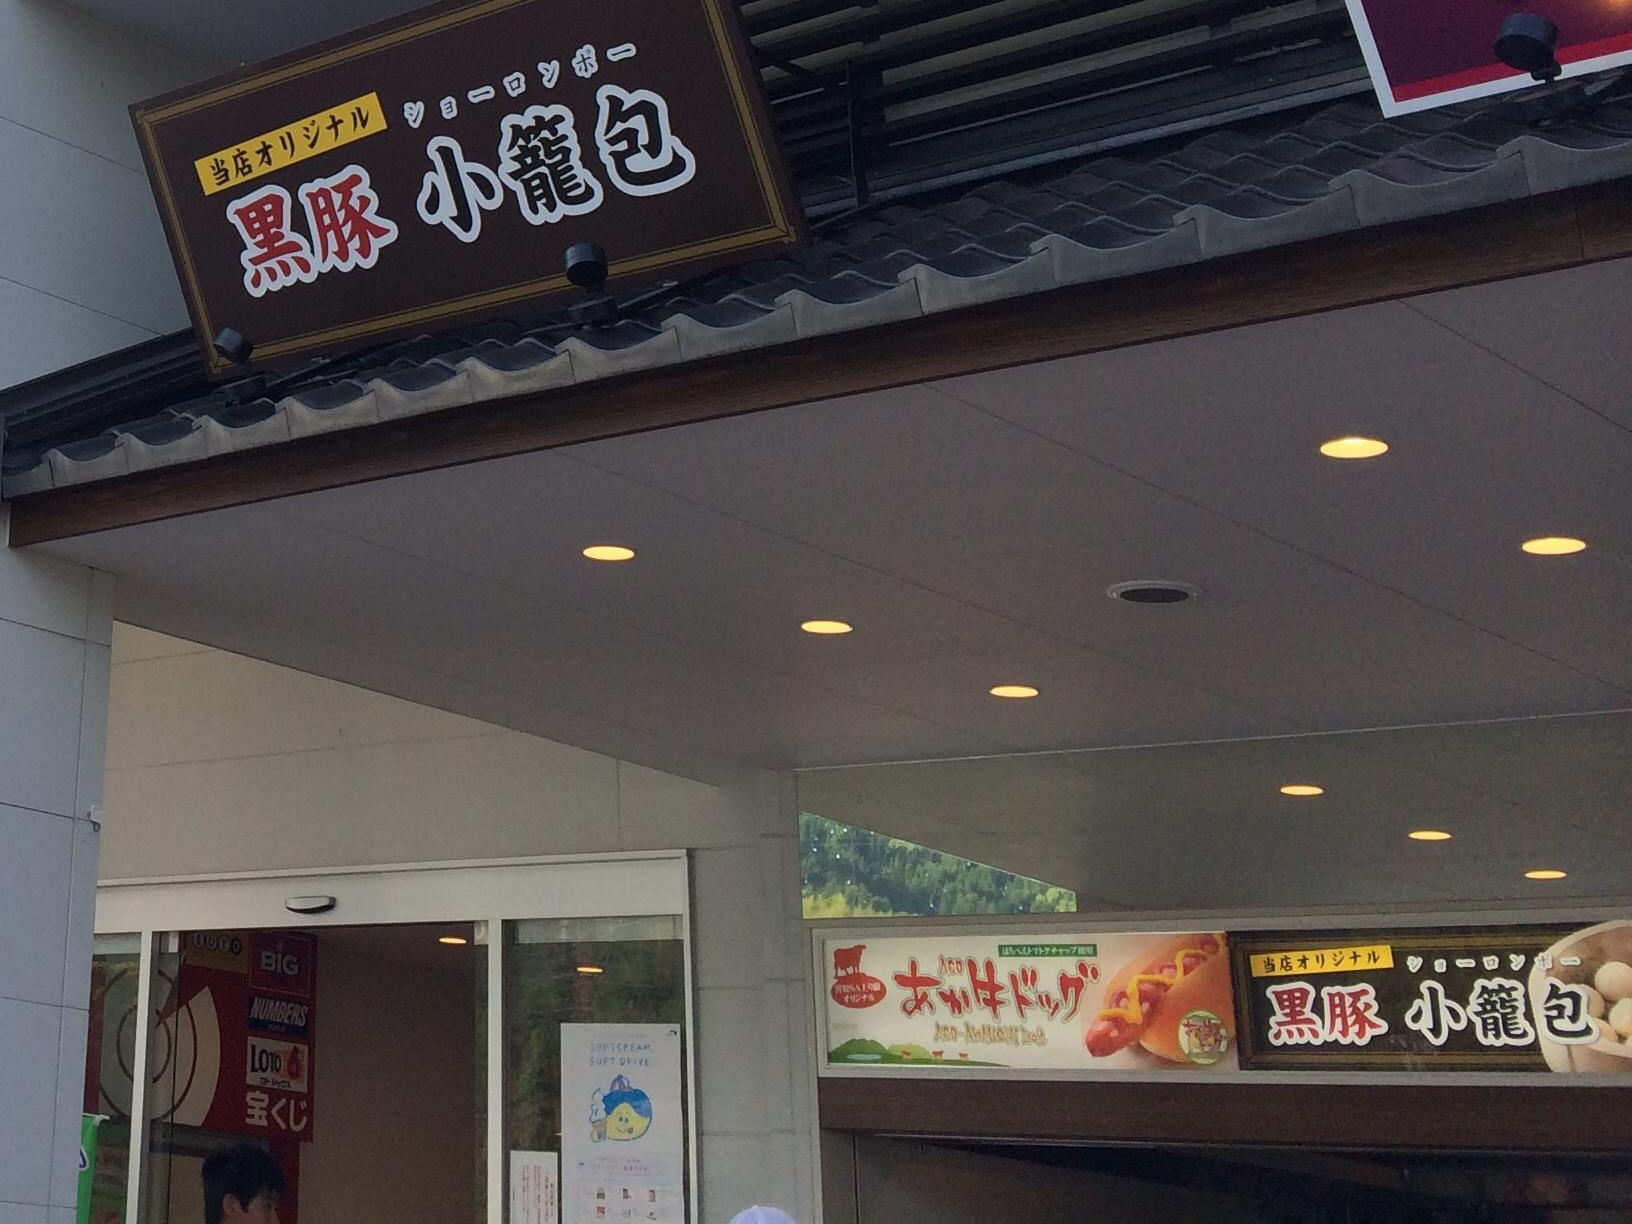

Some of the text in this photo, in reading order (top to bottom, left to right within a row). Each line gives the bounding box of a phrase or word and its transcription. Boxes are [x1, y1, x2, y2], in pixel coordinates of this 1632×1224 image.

[404, 42, 637, 129] ショーロンポー
[209, 104, 371, 187] 当店オリジナル
[227, 84, 696, 298] 黒豚 小籠包
[260, 950, 299, 976] BIG
[1262, 950, 1381, 974] 当店オリジナル
[1406, 953, 1582, 973] ショーロンポー
[249, 996, 309, 1027] NUMBERS
[1266, 982, 1389, 1047] 黒豚
[1404, 978, 1601, 1047] 小籠包
[250, 1044, 283, 1074] LOTO
[245, 1090, 308, 1132] 宝くじ
